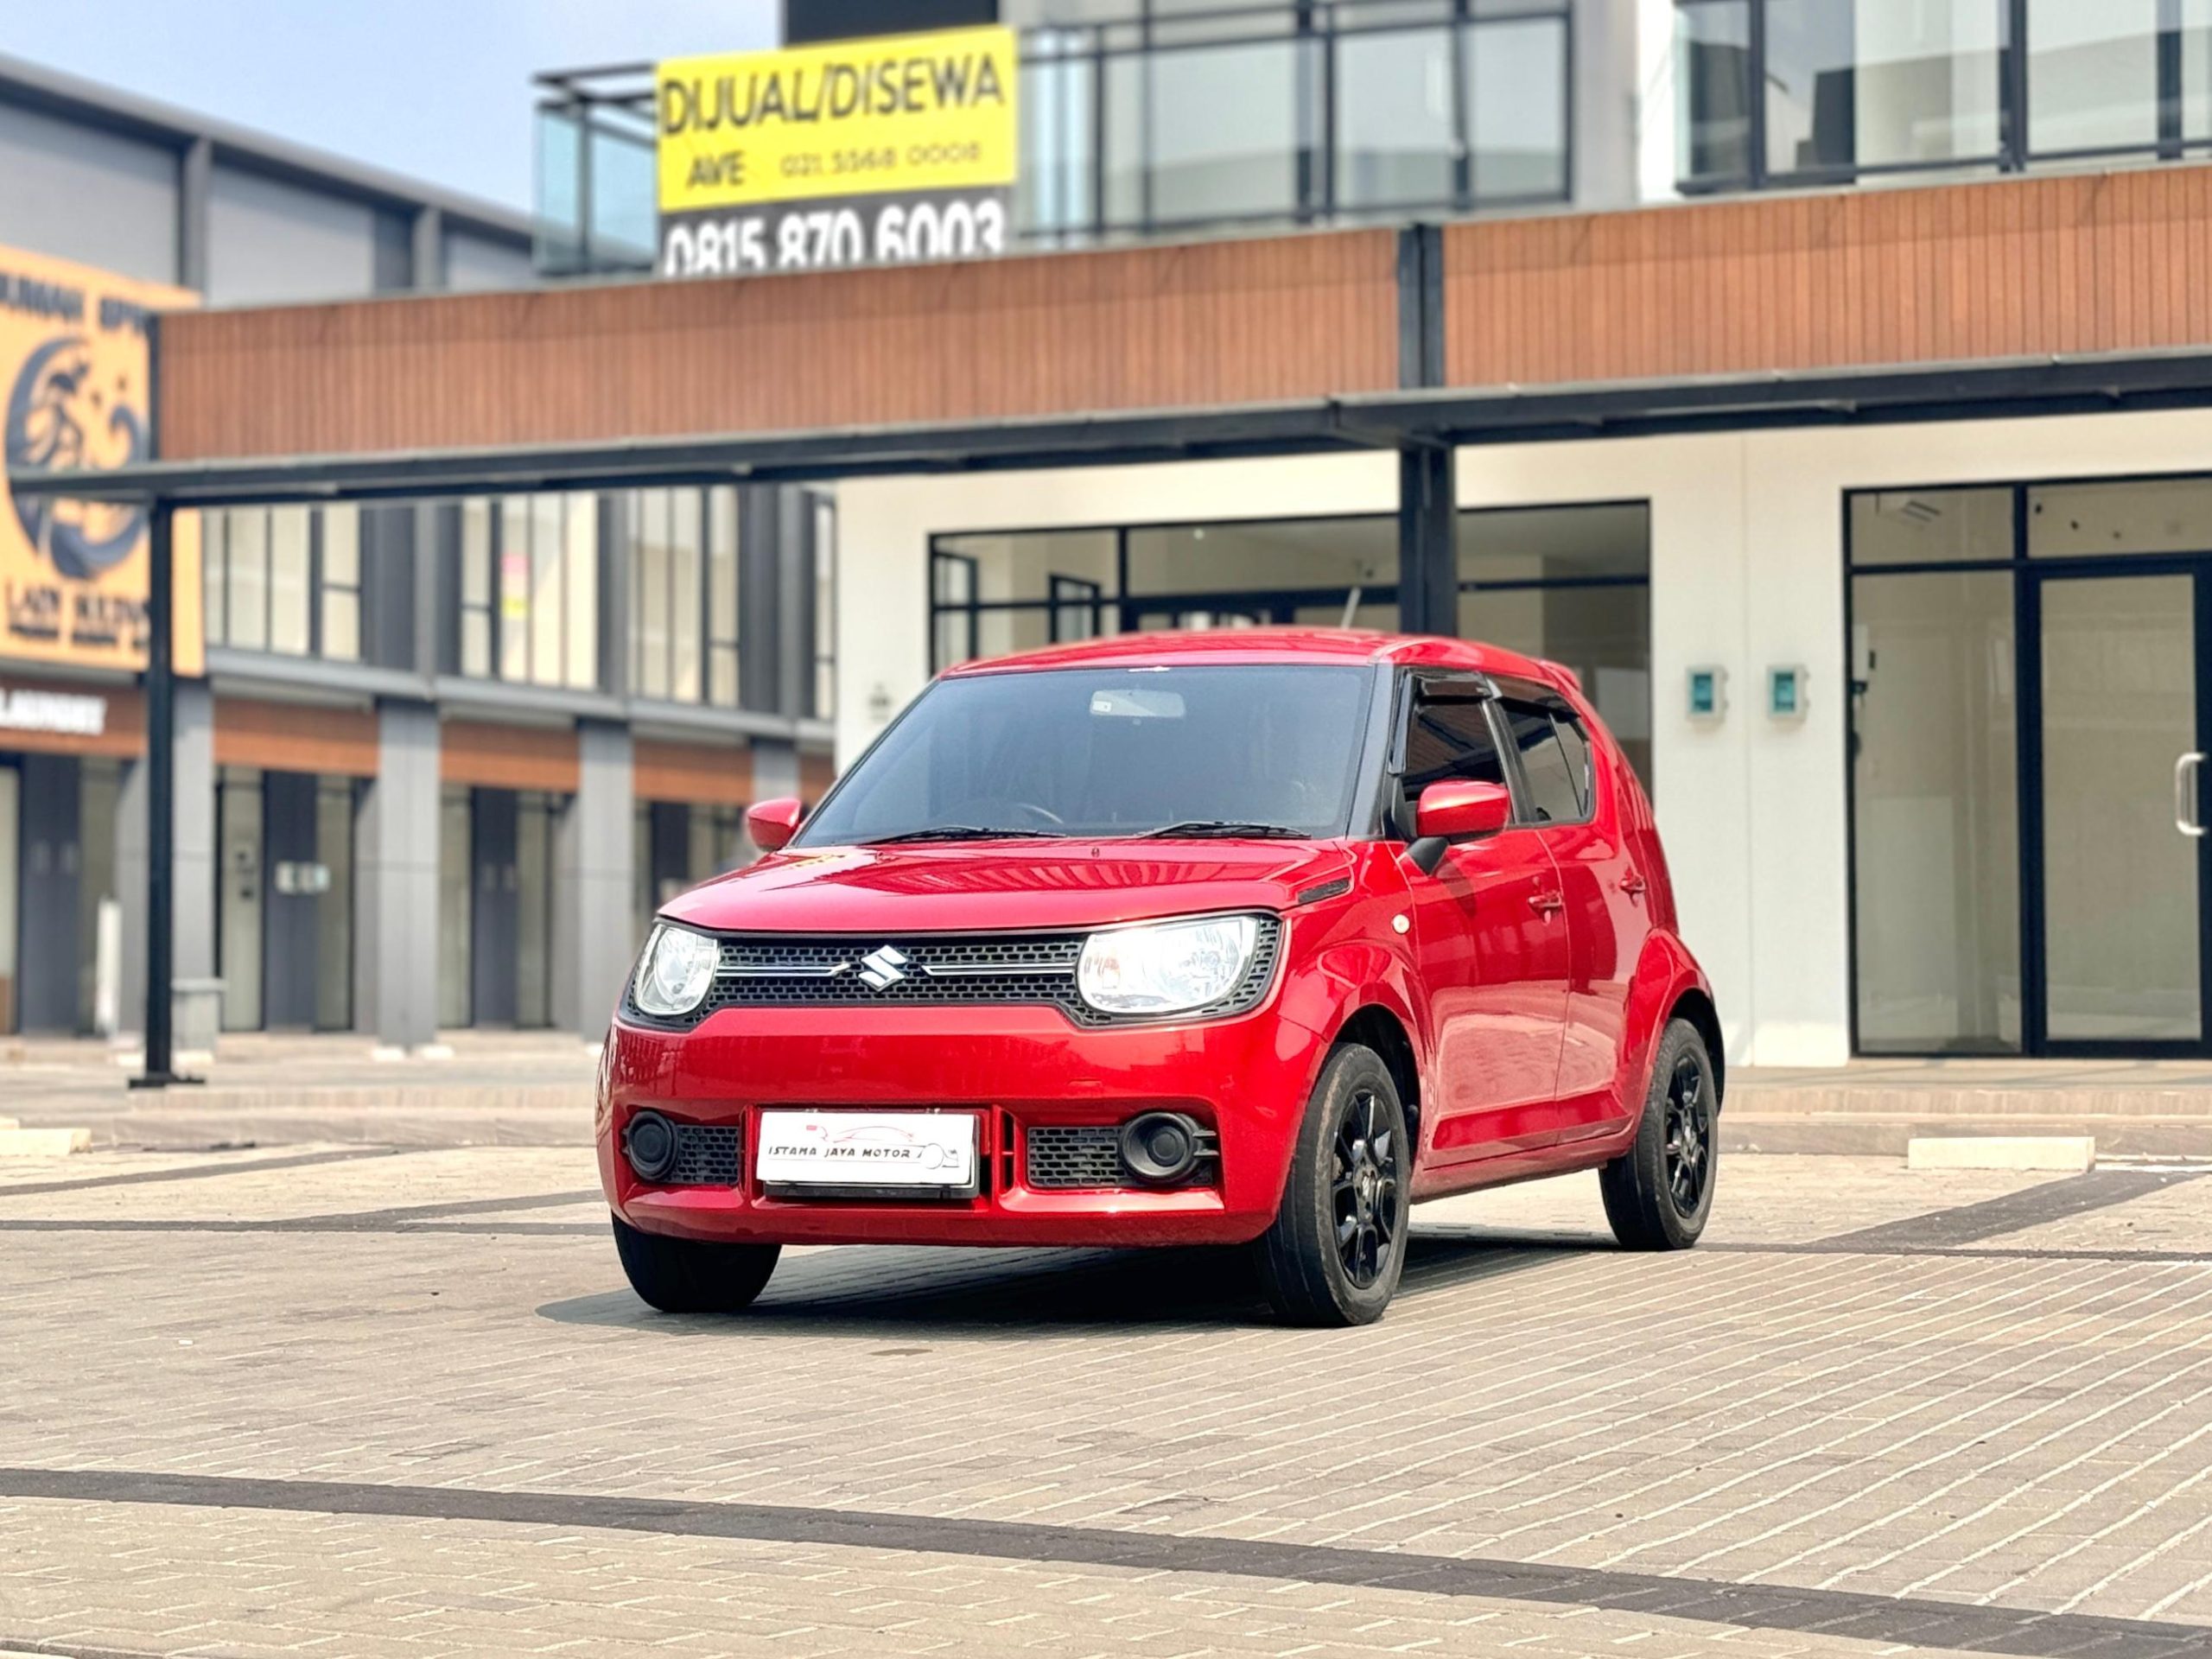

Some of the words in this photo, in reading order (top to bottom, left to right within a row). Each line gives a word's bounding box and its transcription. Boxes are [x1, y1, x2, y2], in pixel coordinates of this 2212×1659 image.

[661, 52, 1005, 136] DIJUAL/DISEWA
[665, 219, 766, 277] 0815
[779, 209, 863, 264] 870
[876, 200, 1005, 261] 6003
[824, 1147, 855, 1159] JAYA
[862, 1148, 910, 1159] MOTOR
